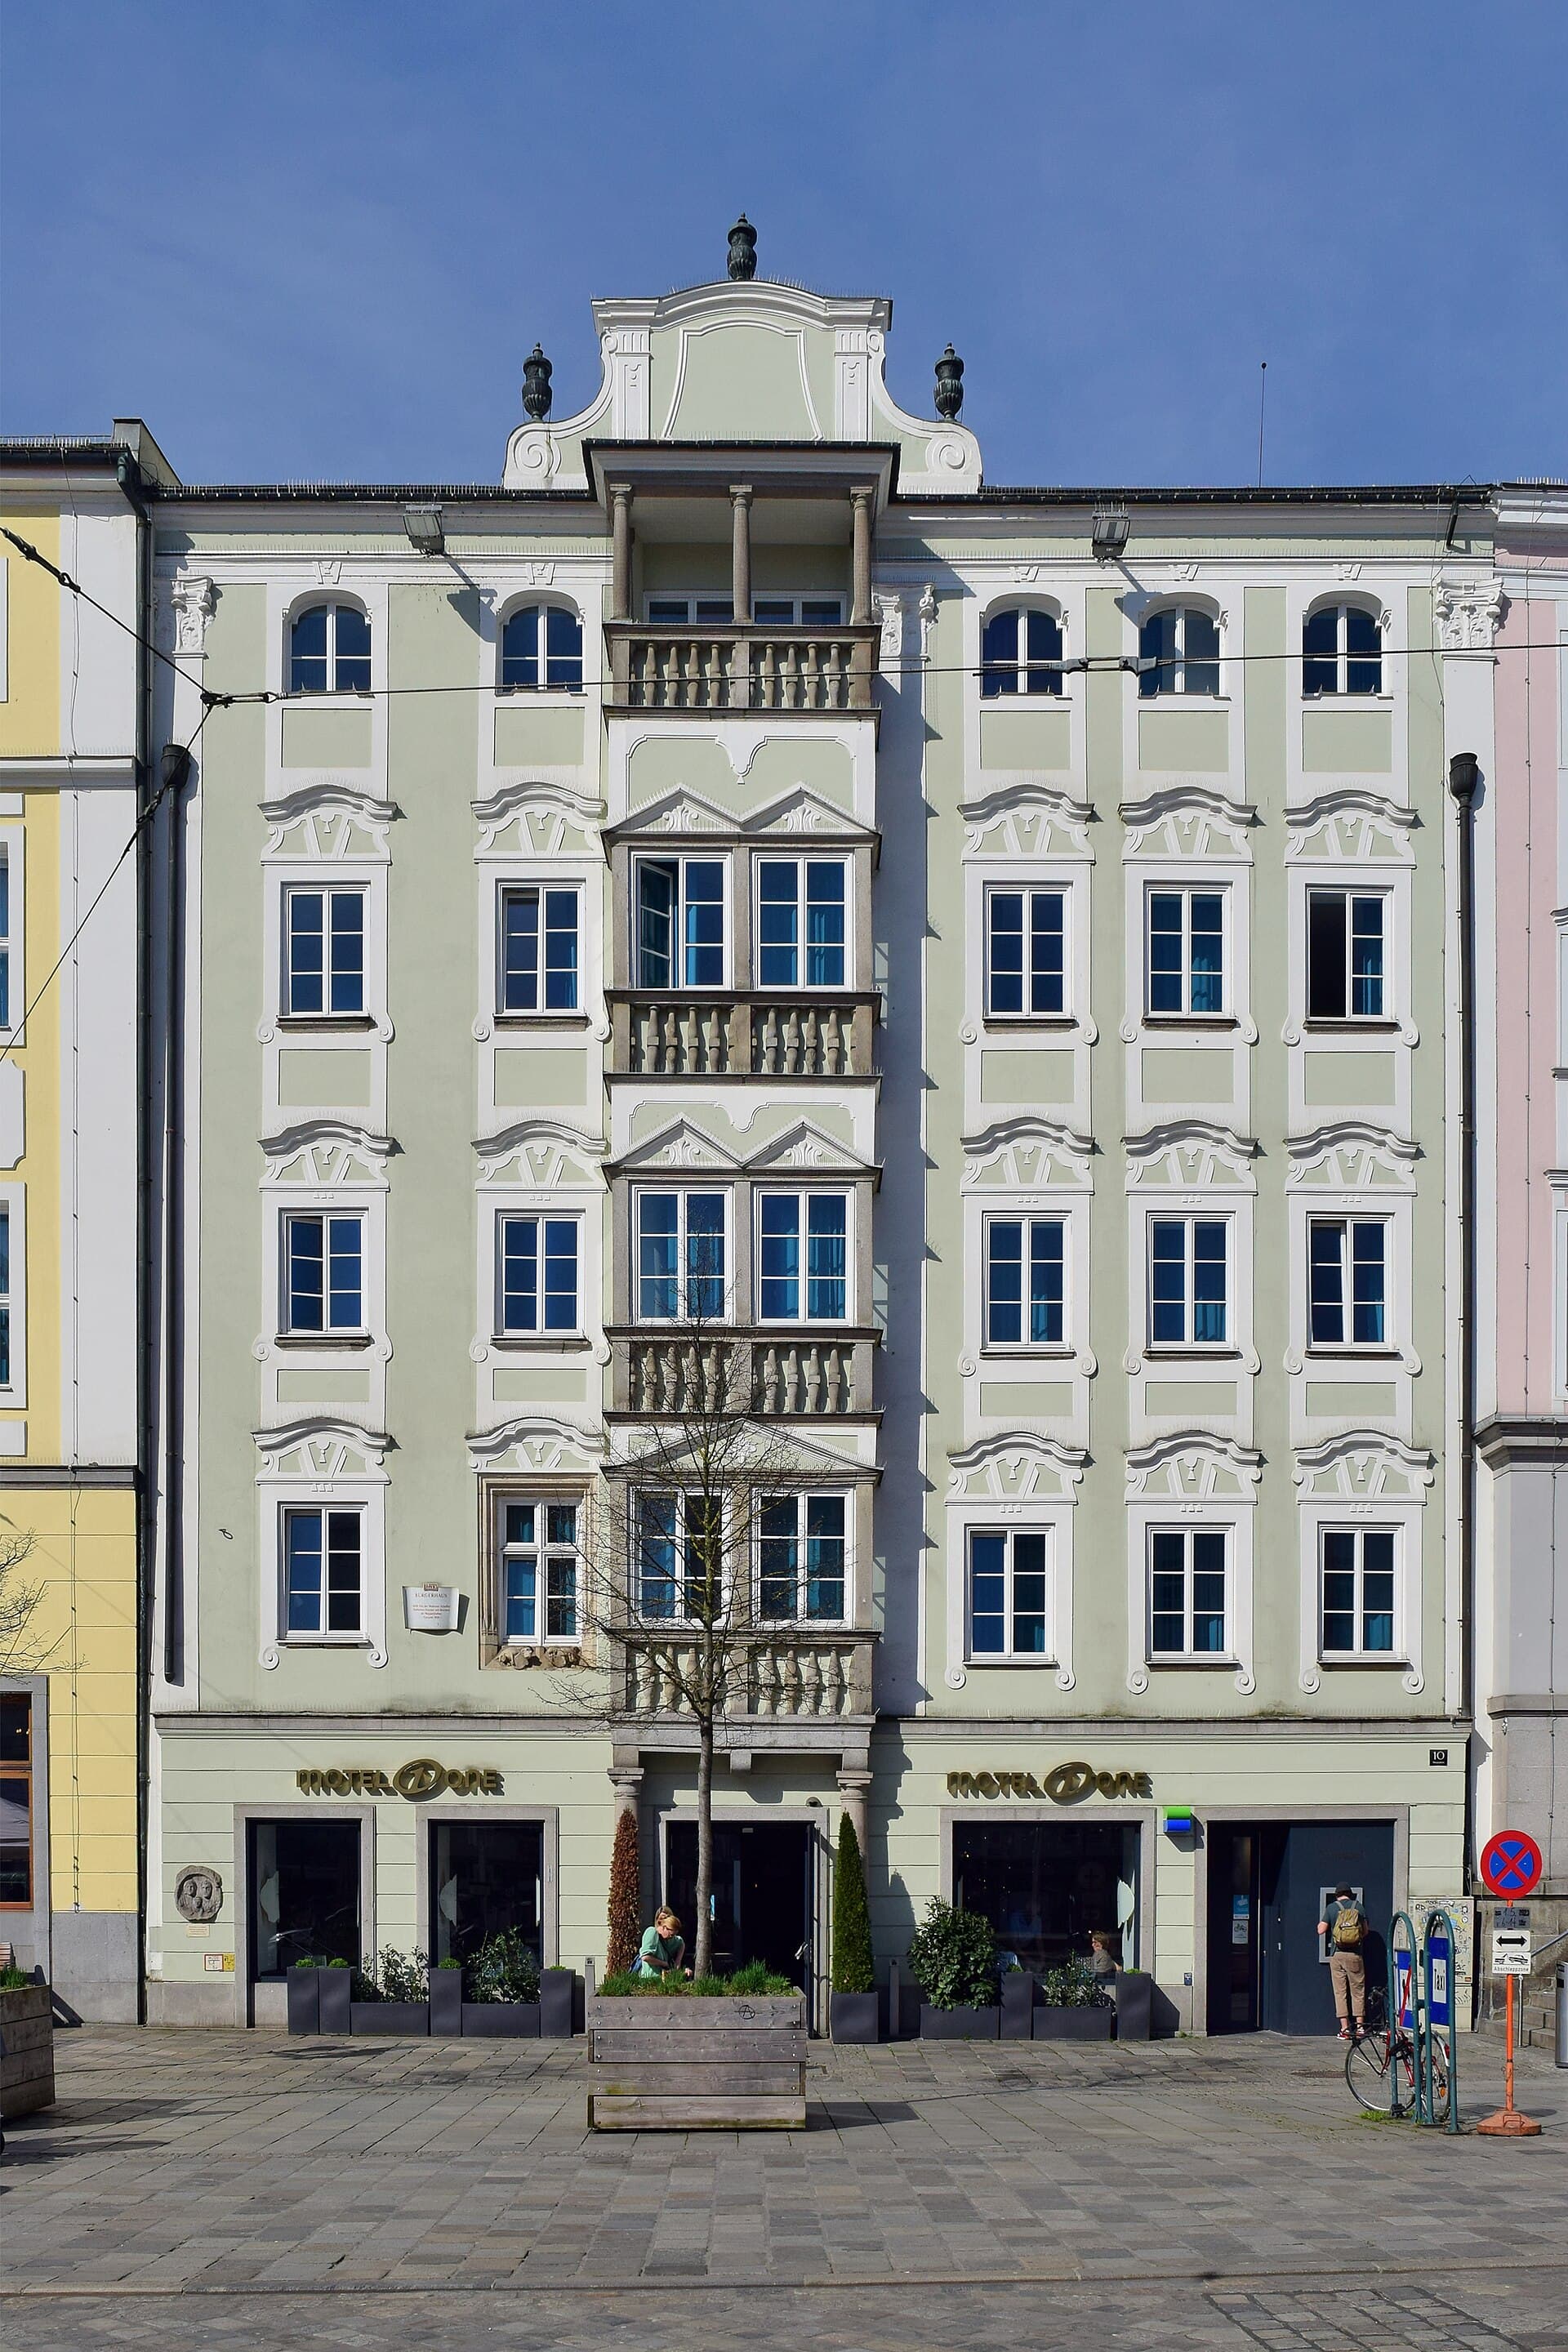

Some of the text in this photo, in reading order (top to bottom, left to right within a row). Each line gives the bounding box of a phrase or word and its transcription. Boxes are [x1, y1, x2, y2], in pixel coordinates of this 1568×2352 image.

[1433, 1751, 1446, 1761] 10
[296, 1769, 392, 1789] MOTEL
[445, 1769, 497, 1788] ONE
[947, 1771, 1041, 1792] MOTEL
[1096, 1771, 1147, 1792] ONE
[1434, 1968, 1446, 1991] Taxi
